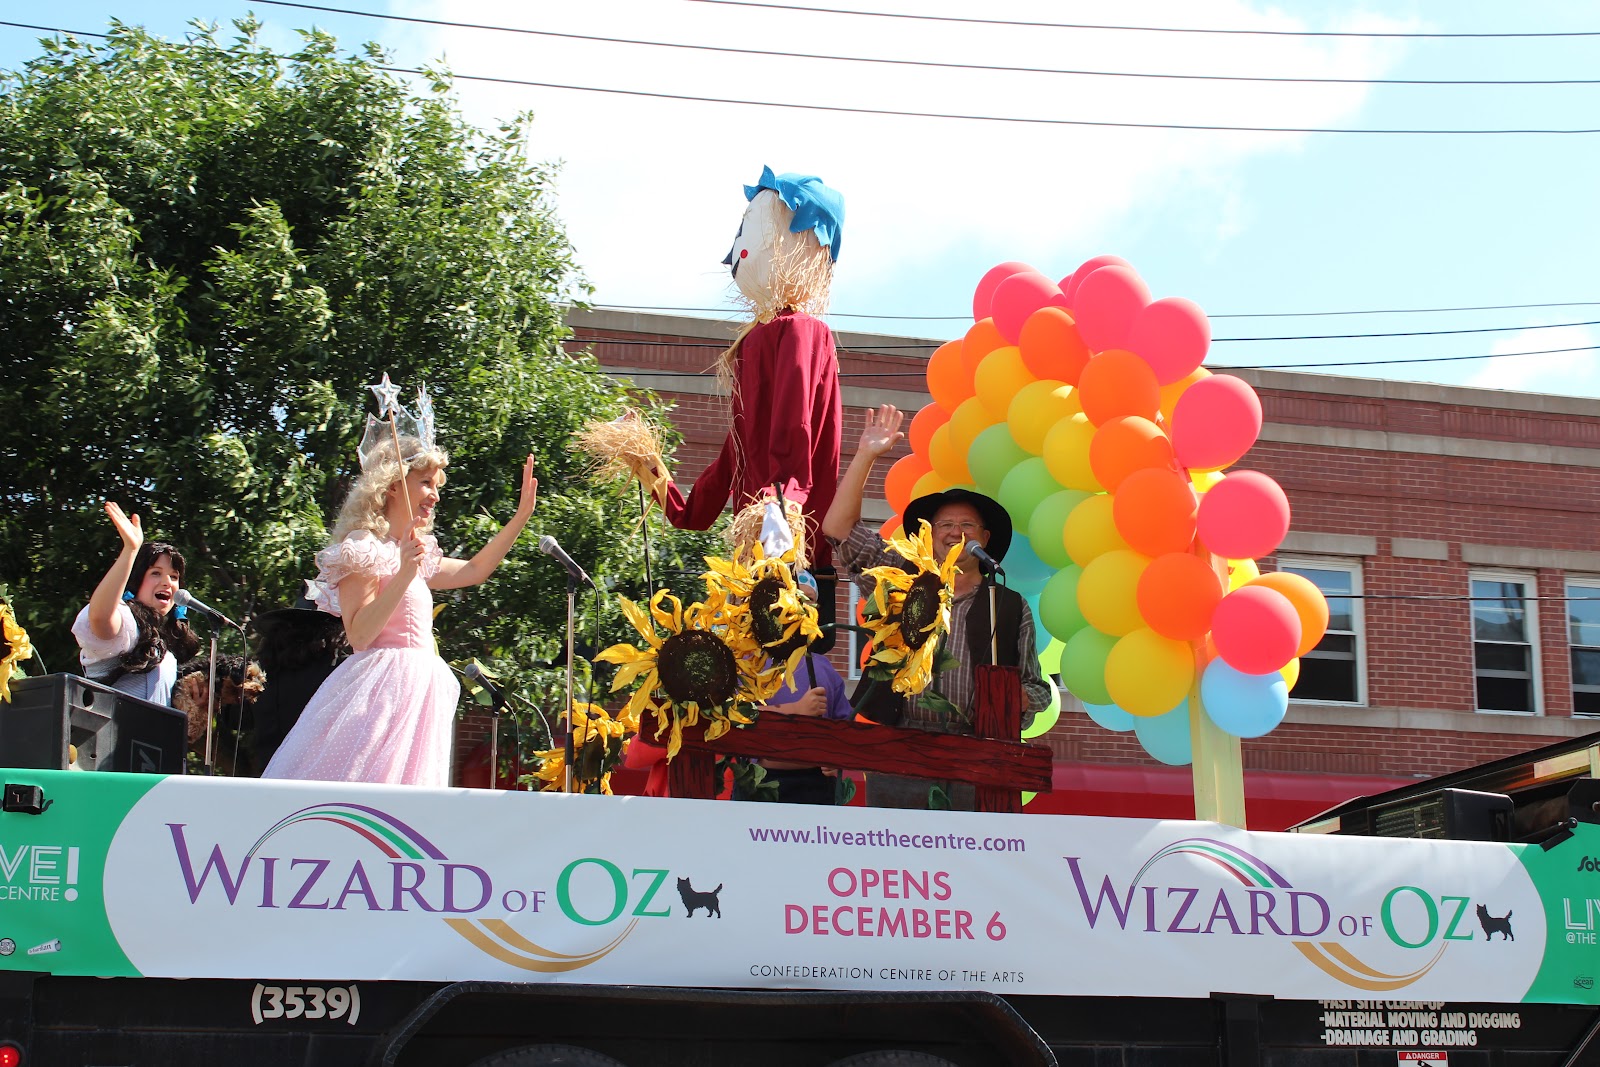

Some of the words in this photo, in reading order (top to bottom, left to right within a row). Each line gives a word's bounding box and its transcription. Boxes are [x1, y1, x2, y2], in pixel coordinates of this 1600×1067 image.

[749, 826, 1026, 852] www.liveatthecentre.com
[165, 822, 493, 914] WIZARD
[501, 889, 546, 913] OF
[827, 867, 952, 901] OPENS
[1063, 856, 1331, 937] WIZARD
[1338, 914, 1373, 937] OF
[785, 904, 975, 939] DECEMBER
[986, 910, 1007, 941] 6
[1563, 898, 1600, 930] LI
[1566, 931, 1597, 945] @THE
[750, 964, 873, 979] CONFEDERATION
[880, 968, 932, 980] CENTRE
[938, 970, 956, 981] OF
[962, 970, 987, 982] THE
[992, 971, 1024, 983] ARTS
[252, 983, 361, 1025] (3539)
[1388, 1012, 1438, 1028] MOVING
[1440, 1012, 1467, 1028] AND
[1469, 1012, 1521, 1029] DIGGING
[1391, 1029, 1418, 1046] AND
[1420, 1029, 1478, 1047] GRADING
[1412, 1052, 1440, 1060] DANGER
